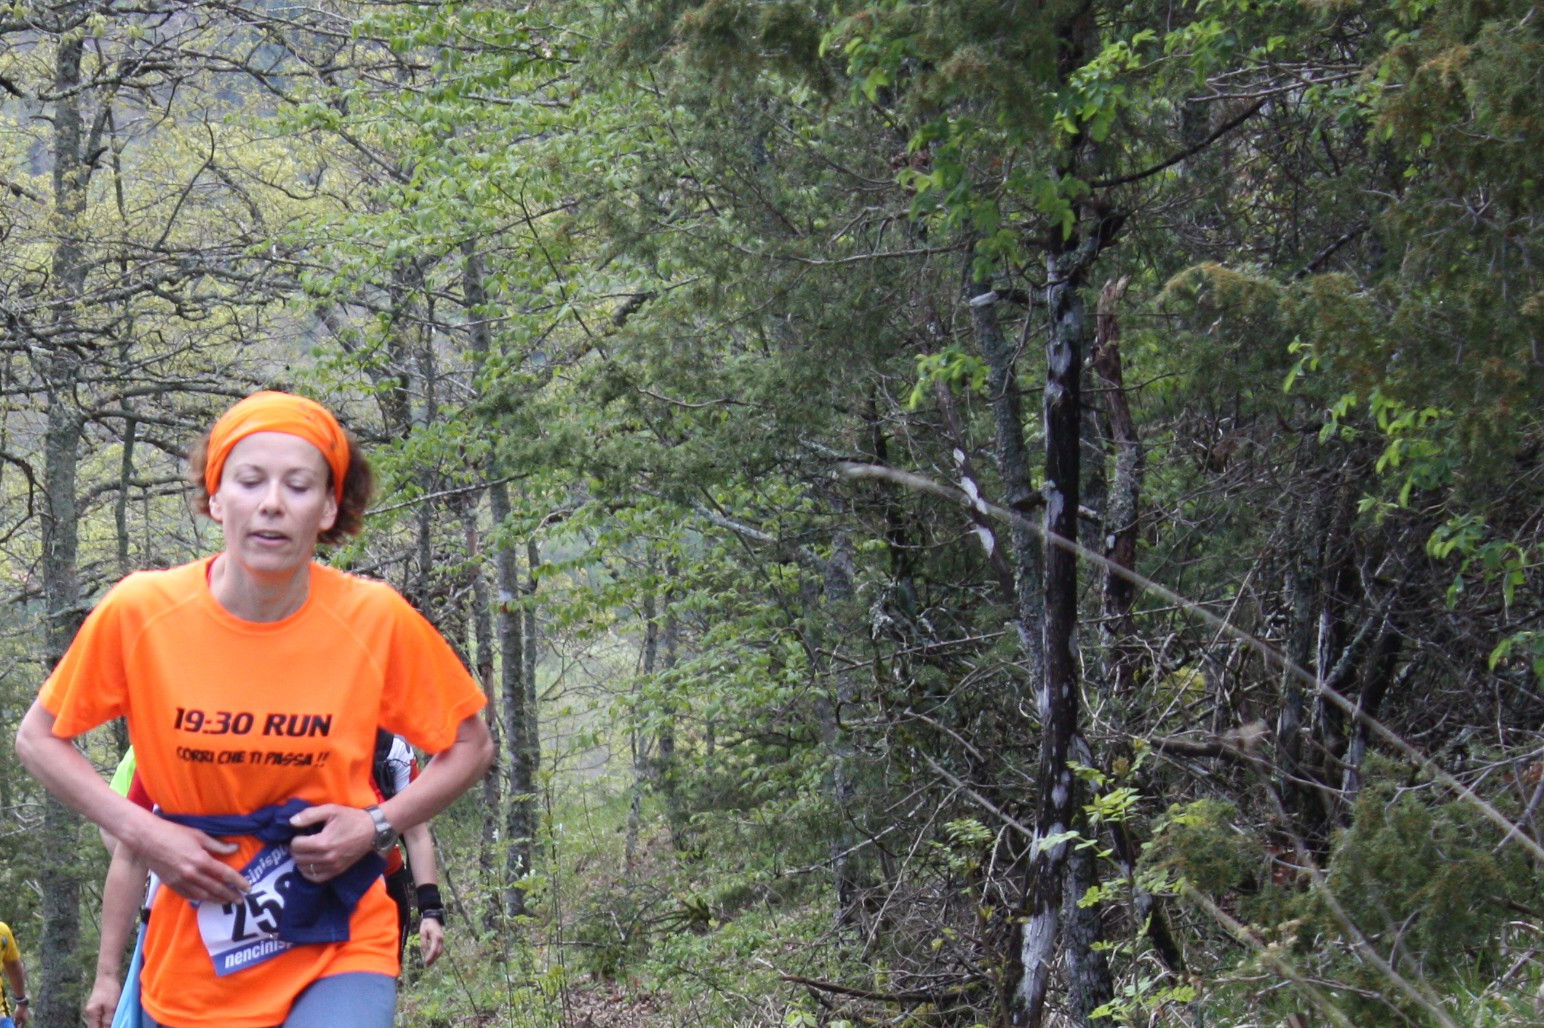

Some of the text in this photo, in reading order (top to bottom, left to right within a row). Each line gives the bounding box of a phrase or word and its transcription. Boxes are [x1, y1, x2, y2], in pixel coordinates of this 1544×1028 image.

[263, 714, 332, 737] RUN
[177, 746, 214, 763] CORRI
[218, 751, 245, 764] CHE
[250, 752, 262, 763] TI
[265, 752, 313, 766] PASSA
